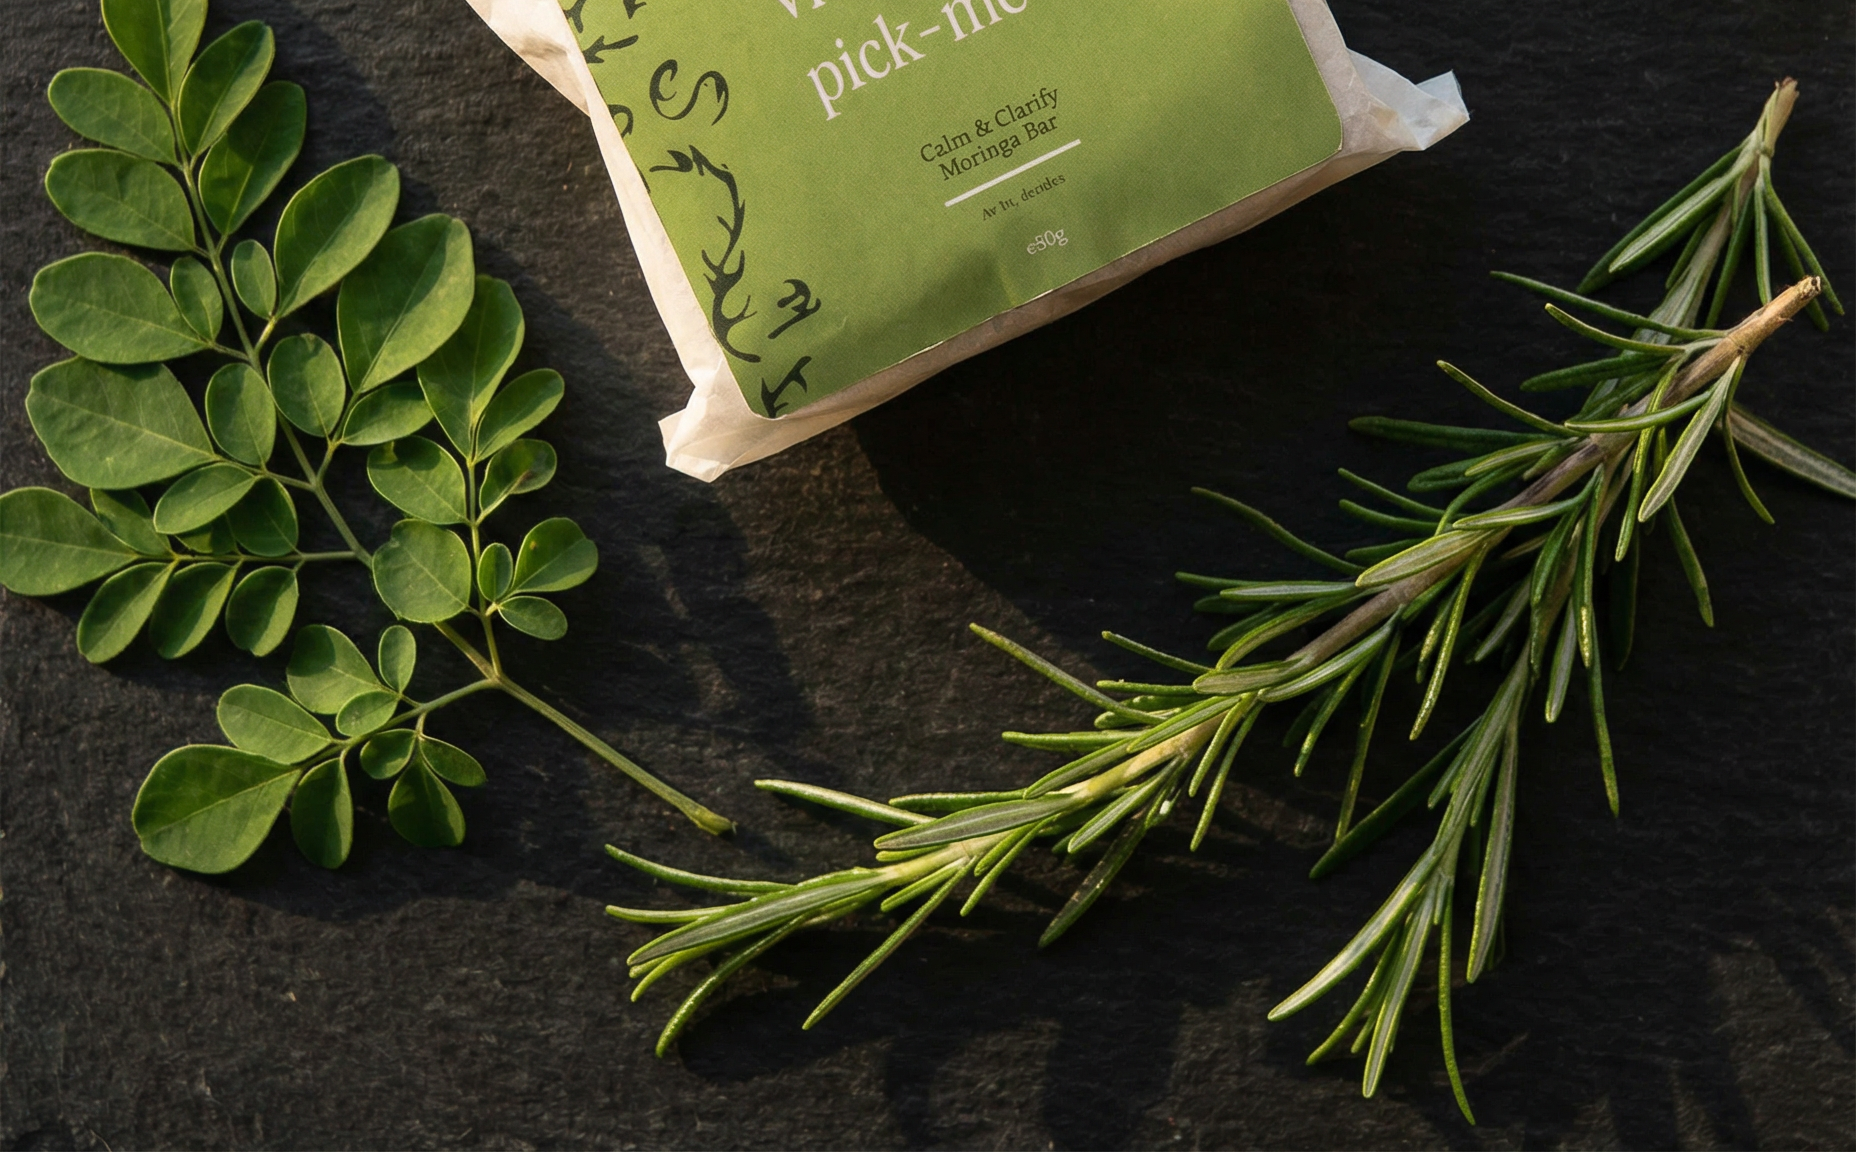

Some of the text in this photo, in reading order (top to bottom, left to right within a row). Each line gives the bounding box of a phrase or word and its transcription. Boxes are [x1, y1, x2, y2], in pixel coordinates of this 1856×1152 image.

[920, 87, 1058, 162] Calm & Clarify
[938, 115, 1058, 181] Moringa Bar
